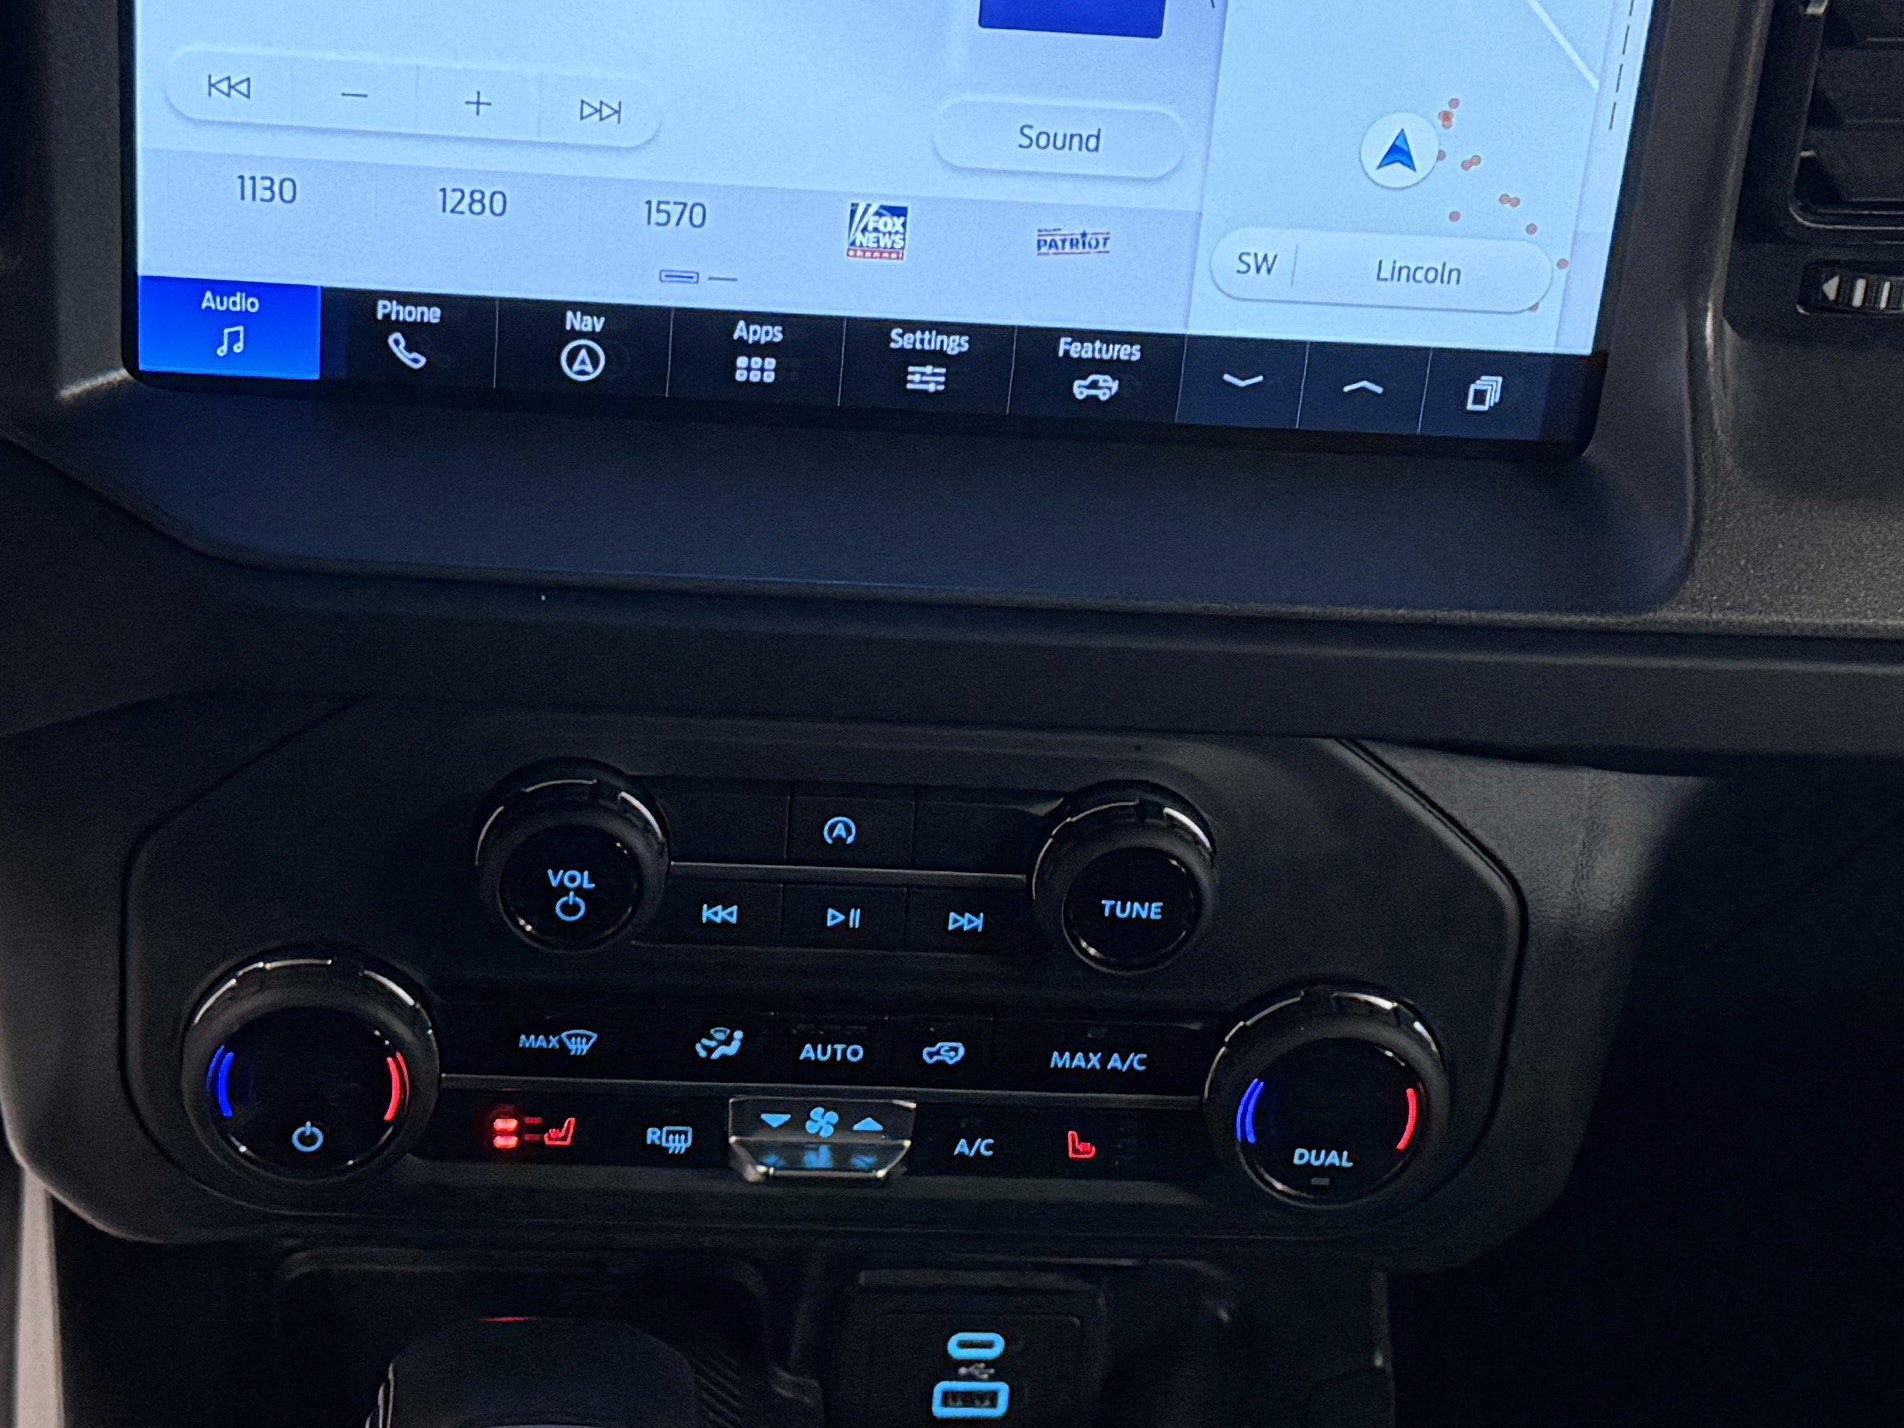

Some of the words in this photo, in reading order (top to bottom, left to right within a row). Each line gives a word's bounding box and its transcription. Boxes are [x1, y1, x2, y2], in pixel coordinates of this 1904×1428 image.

[1017, 123, 1103, 155] Sound
[235, 174, 298, 205] 1130
[437, 187, 509, 218] 1280
[643, 199, 708, 231] 1570
[867, 214, 906, 233] FOX
[854, 232, 905, 249] NEWS
[1036, 233, 1111, 252] PATRIOT
[1235, 250, 1279, 277] SW
[1375, 257, 1463, 287] Lincoln
[200, 289, 261, 316] Audio
[376, 298, 443, 327] Phone
[564, 309, 606, 334] Nav
[733, 319, 785, 347] Apps
[889, 327, 971, 357] Settings
[1057, 336, 1143, 364] Features
[547, 869, 595, 890] VOL
[1101, 899, 1163, 920] TUNE
[518, 1033, 559, 1051] MAX
[799, 1043, 865, 1063] AUTO
[1050, 1051, 1102, 1071] MAX
[1107, 1051, 1147, 1073] A/C
[954, 1138, 994, 1158] A/C
[1293, 1148, 1354, 1169] DUAL
